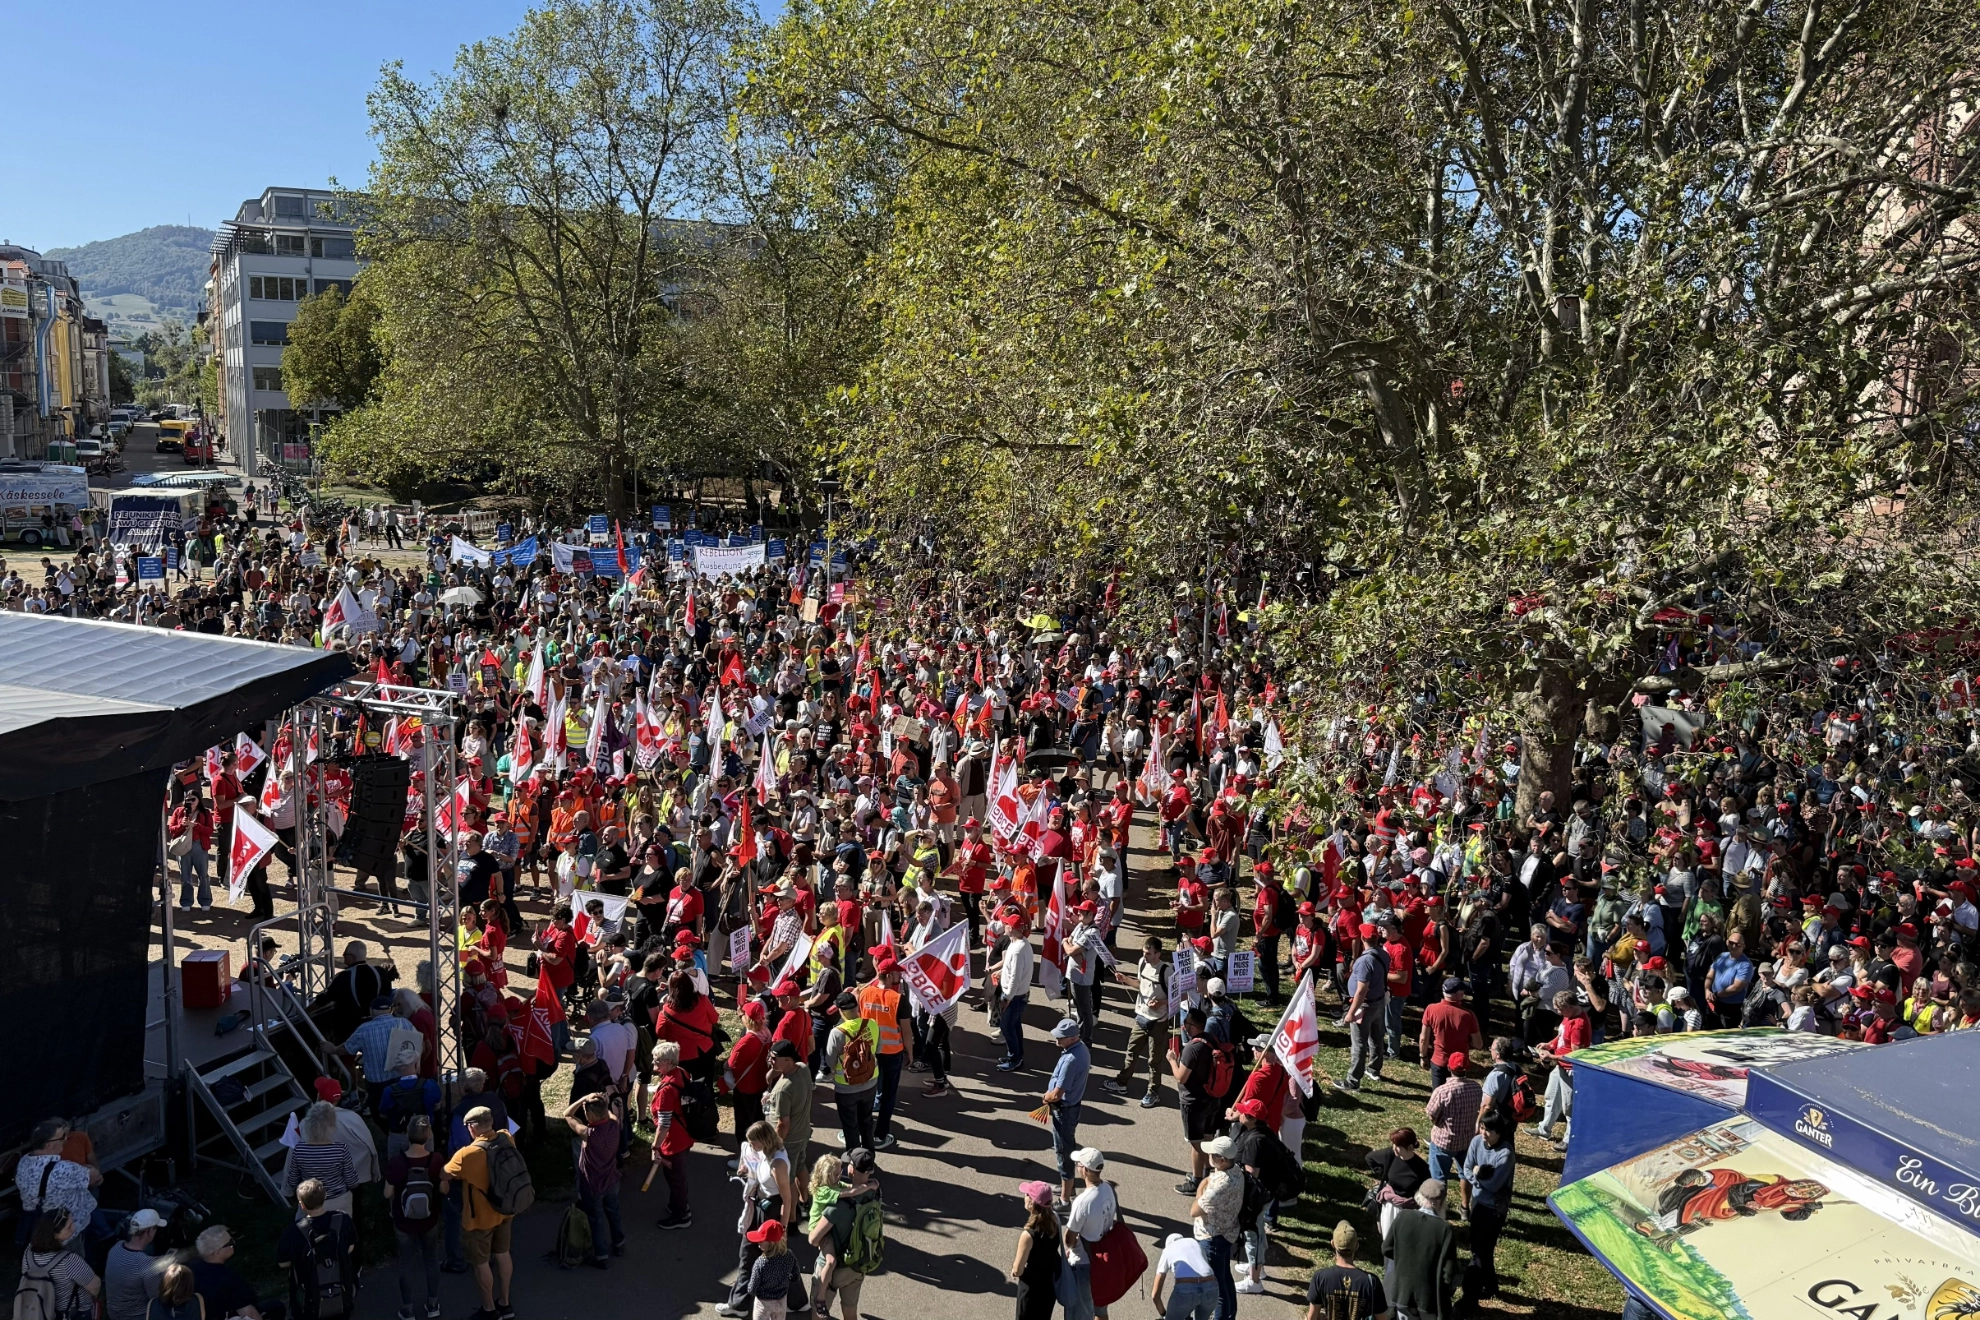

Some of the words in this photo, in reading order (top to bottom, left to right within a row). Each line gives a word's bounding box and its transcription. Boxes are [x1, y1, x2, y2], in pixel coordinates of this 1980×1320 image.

[114, 511, 128, 519] DIE
[700, 549, 743, 557] REBELLION
[700, 561, 742, 572] Ausbeutung
[1178, 950, 1191, 960] MERZ
[1234, 953, 1249, 961] MERZ
[1178, 958, 1191, 968] MUSS
[1233, 961, 1249, 969] MUSS
[1180, 966, 1192, 976] WEG!
[1233, 969, 1249, 977] WEG!
[911, 975, 944, 1009] BCE
[1276, 1033, 1290, 1053] IG
[1795, 1119, 1833, 1148] GANTER
[1895, 1154, 1940, 1197] Ein
[1873, 1257, 1975, 1276] PRIVATBRA
[1807, 1278, 1899, 1320] GA
